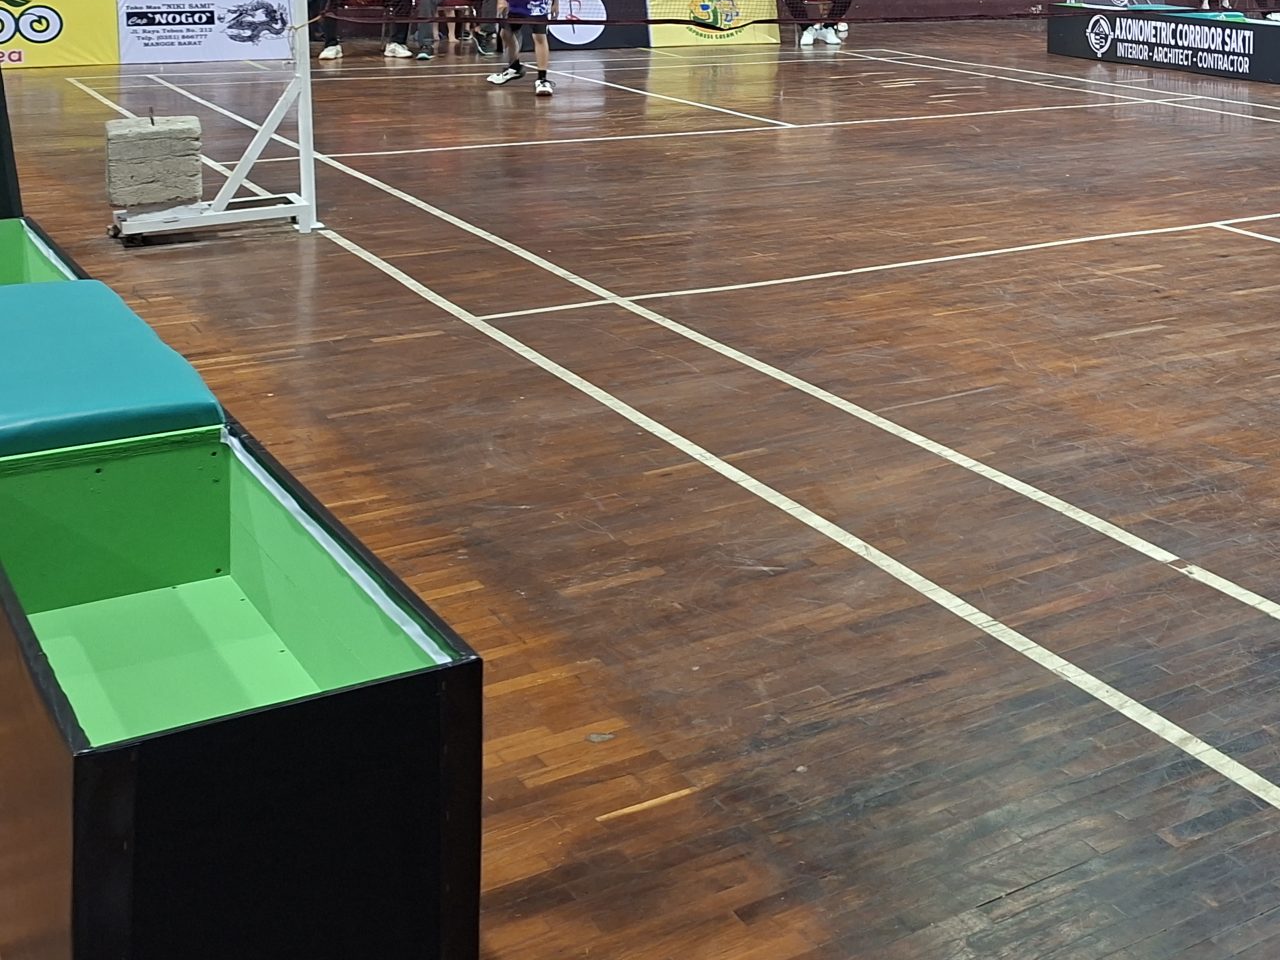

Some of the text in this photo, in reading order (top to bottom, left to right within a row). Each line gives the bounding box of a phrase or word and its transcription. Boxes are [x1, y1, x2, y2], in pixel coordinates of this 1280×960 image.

[1114, 17, 1254, 55] AXONOMETRIC CORRIDOR SAKTI
[1116, 42, 1149, 60] INTERIOR
[1152, 46, 1193, 66] ARCHITECT
[1197, 52, 1250, 73] CONTRACTOR
